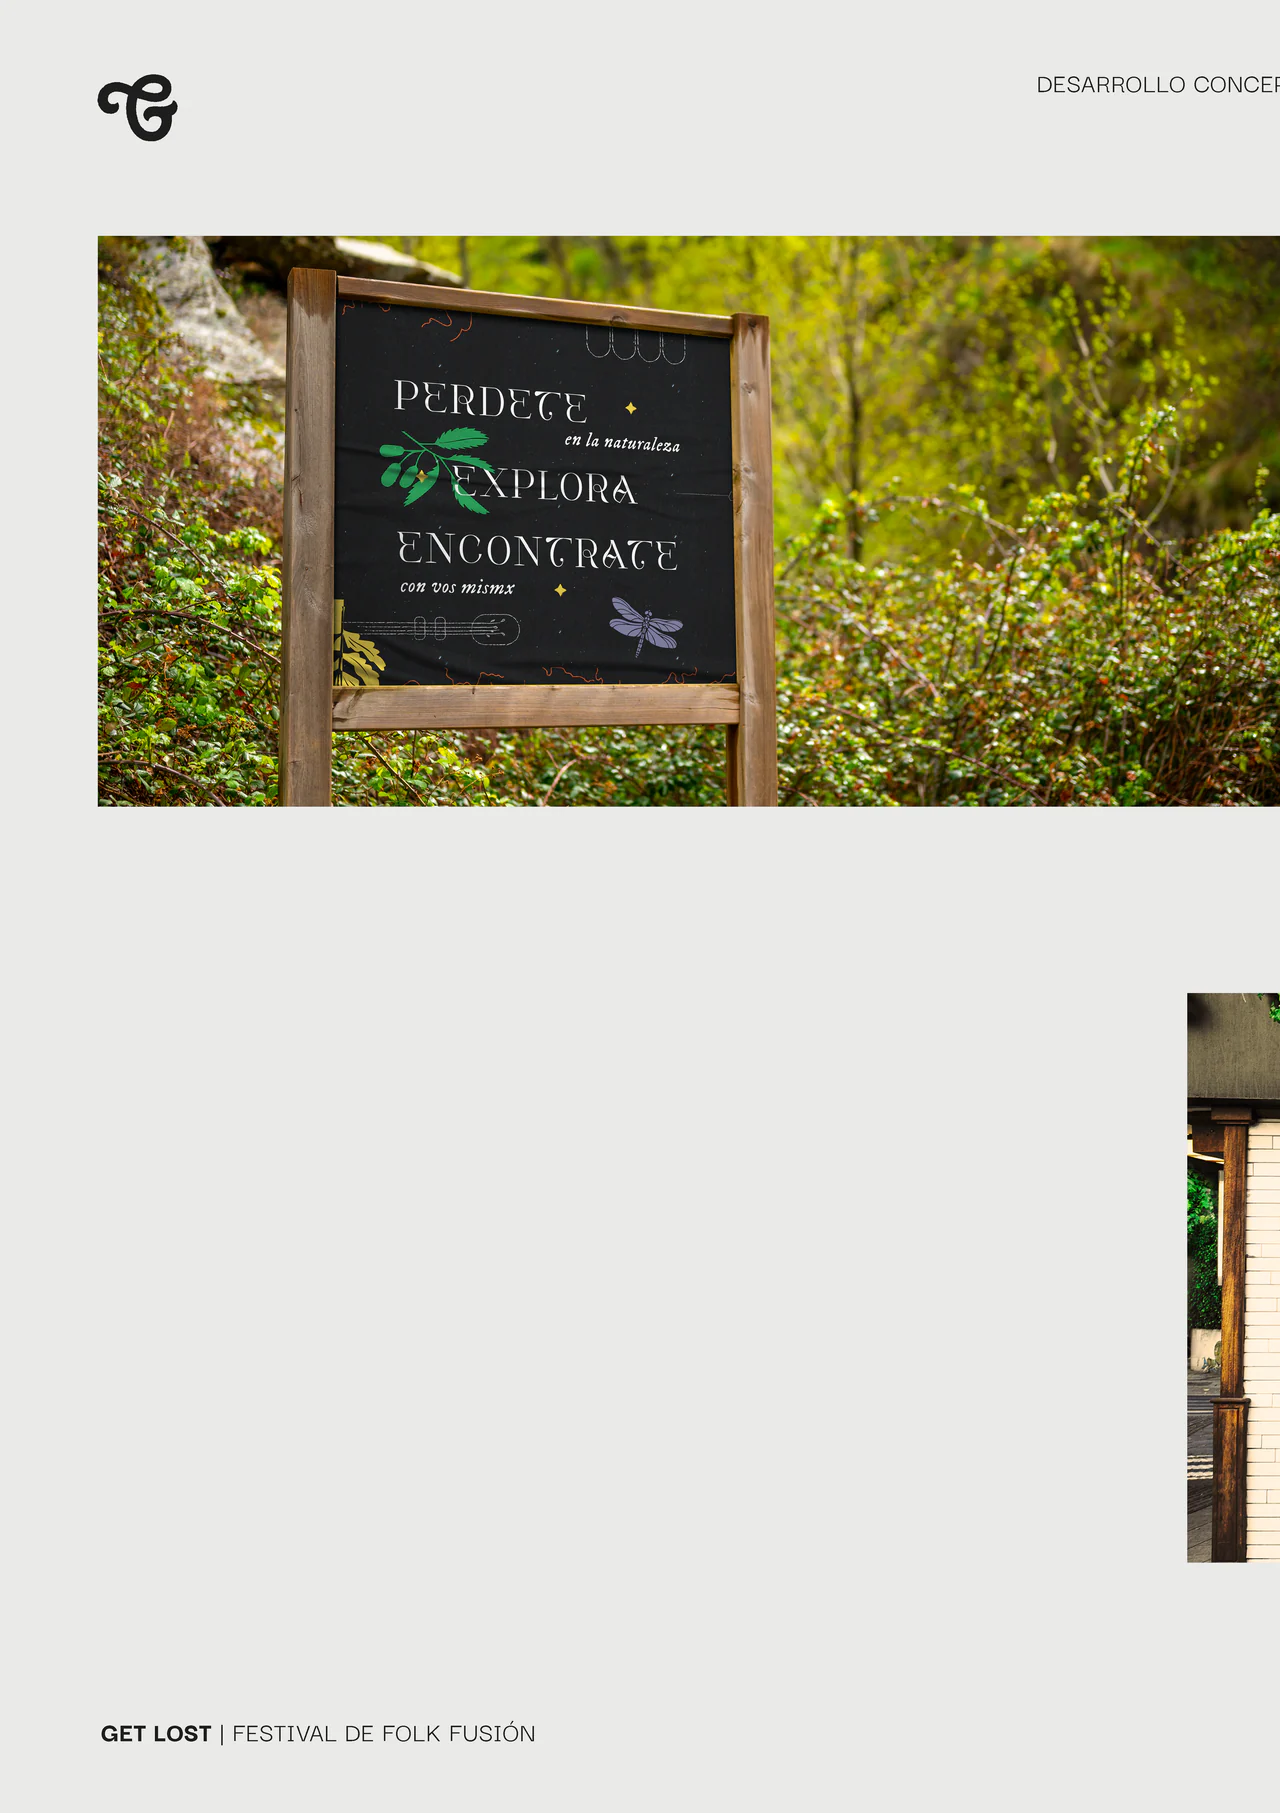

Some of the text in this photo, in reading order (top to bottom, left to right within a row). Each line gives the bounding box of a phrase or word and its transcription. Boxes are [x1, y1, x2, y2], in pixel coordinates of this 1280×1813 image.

[1037, 75, 1186, 94] DESARROLLO
[393, 379, 588, 424] PERDETE
[564, 431, 681, 453] en la naturaleza
[452, 464, 639, 506] EXPLORA
[396, 530, 679, 572] ENCONTRATE
[400, 578, 516, 595] con vos mismx
[100, 1724, 147, 1743] GET
[154, 1724, 212, 1743] LOST
[233, 1724, 337, 1743] FESTIVAL
[345, 1724, 374, 1742] DE
[383, 1724, 441, 1743] FOLK
[450, 1720, 535, 1743] FUSIÓN
